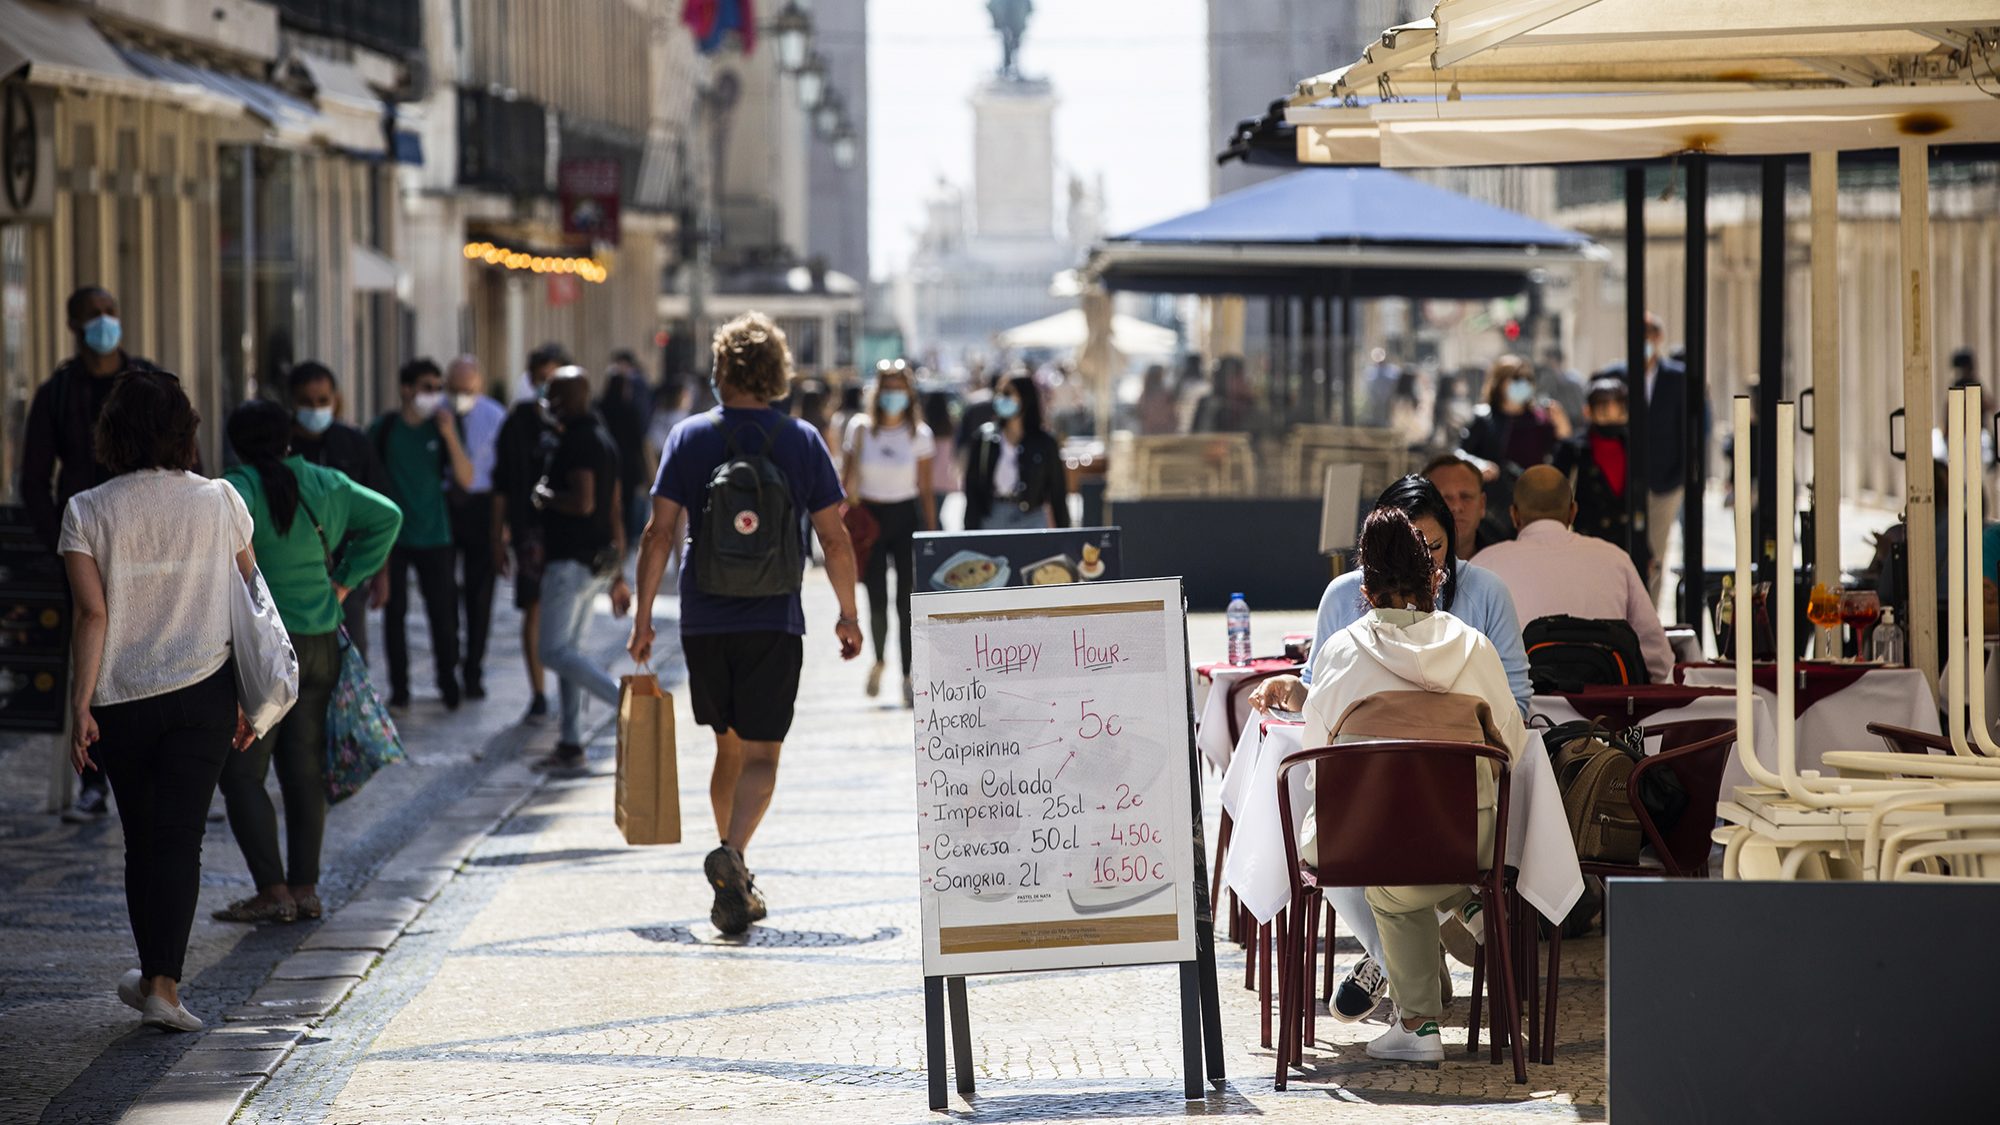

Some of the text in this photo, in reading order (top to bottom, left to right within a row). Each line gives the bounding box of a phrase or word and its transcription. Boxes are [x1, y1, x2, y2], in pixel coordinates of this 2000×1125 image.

[975, 633, 1042, 674] Happy
[1078, 699, 1122, 739] 5€
[930, 768, 1052, 798] Pina Colada
[1042, 793, 1085, 820] 25cl
[1115, 783, 1144, 811] 2€
[1031, 824, 1080, 854] 50cl
